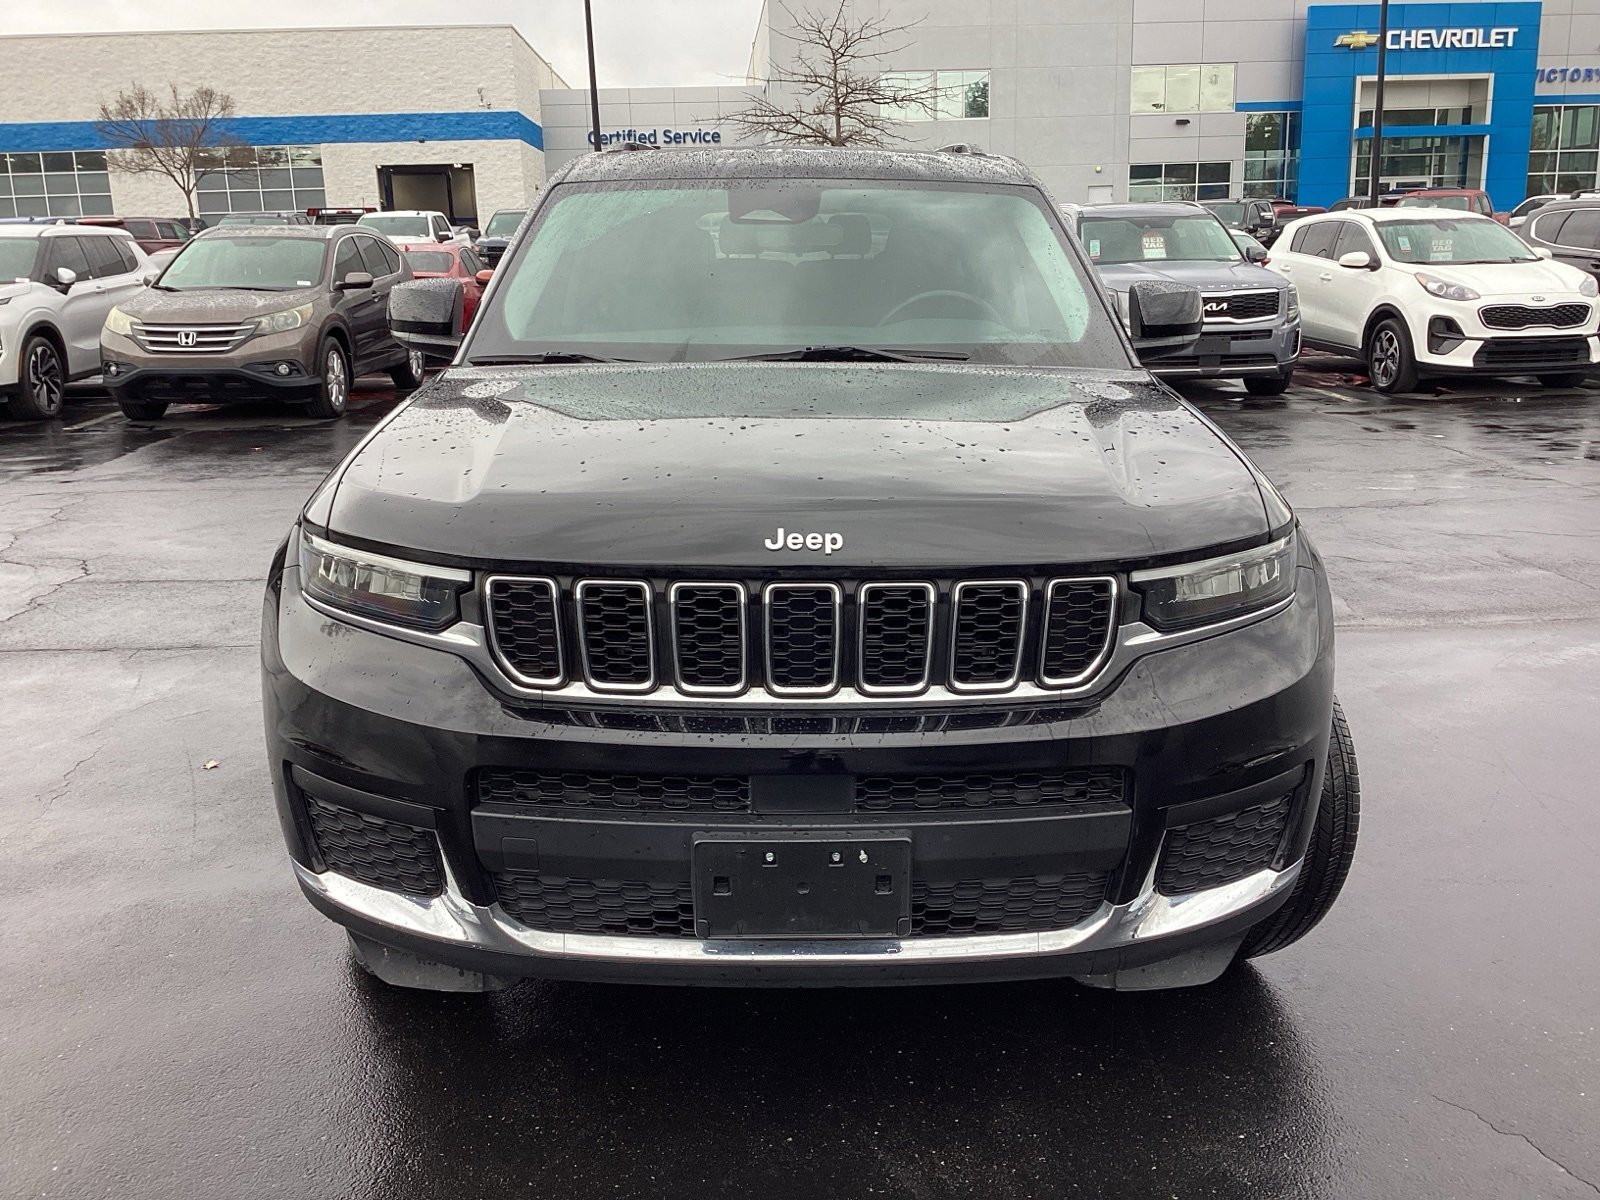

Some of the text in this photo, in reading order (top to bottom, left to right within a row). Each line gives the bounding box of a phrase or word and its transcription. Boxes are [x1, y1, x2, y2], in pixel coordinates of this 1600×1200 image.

[1386, 27, 1519, 50] CHEVROLET
[587, 128, 721, 145] Certified Service
[764, 527, 844, 555] Jeep
